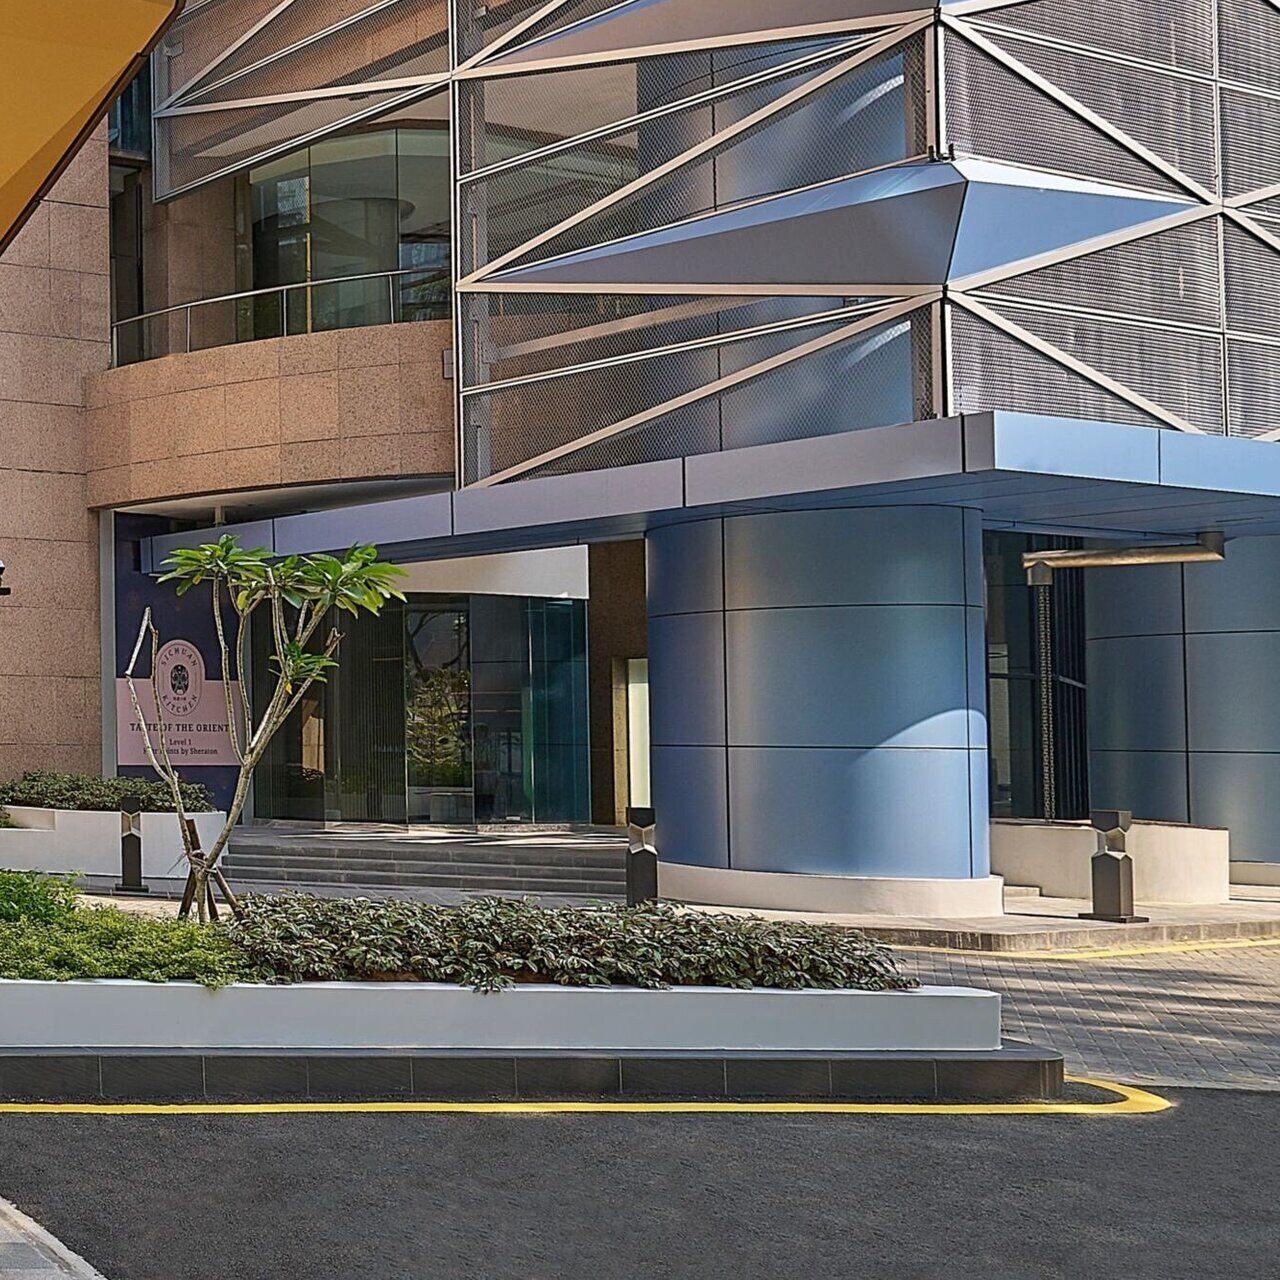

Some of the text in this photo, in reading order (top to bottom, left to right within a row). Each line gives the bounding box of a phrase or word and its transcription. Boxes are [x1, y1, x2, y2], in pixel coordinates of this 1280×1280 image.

[161, 648, 197, 666] SICHUAN
[162, 694, 197, 713] KITCHEN
[130, 723, 158, 732] TATE
[175, 723, 193, 732] THE
[196, 723, 230, 732] ORIENT
[169, 738, 186, 746] Level
[180, 747, 188, 757] by
[190, 747, 218, 755] Sheraton
